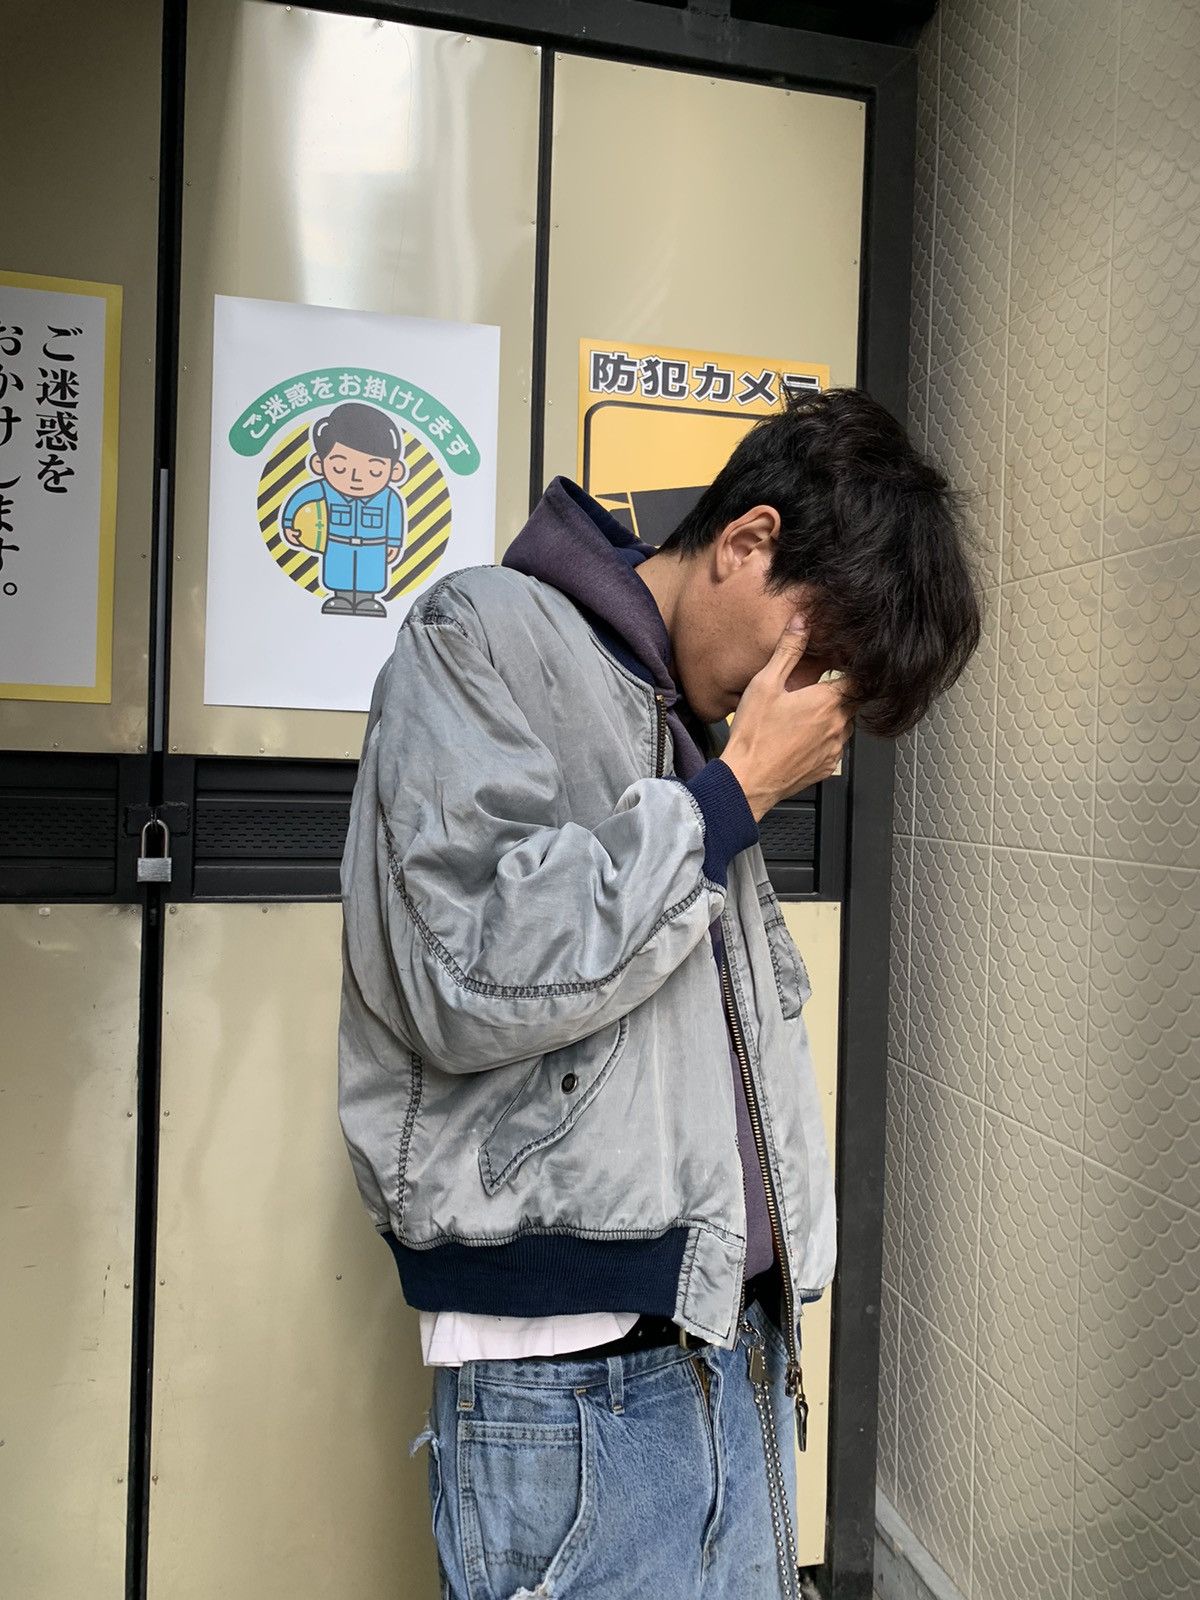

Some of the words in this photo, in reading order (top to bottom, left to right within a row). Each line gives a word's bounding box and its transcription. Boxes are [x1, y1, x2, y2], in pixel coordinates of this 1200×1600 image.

[35, 325, 83, 494] ご迷惑を
[242, 373, 471, 457] ご迷惑をお掛けします
